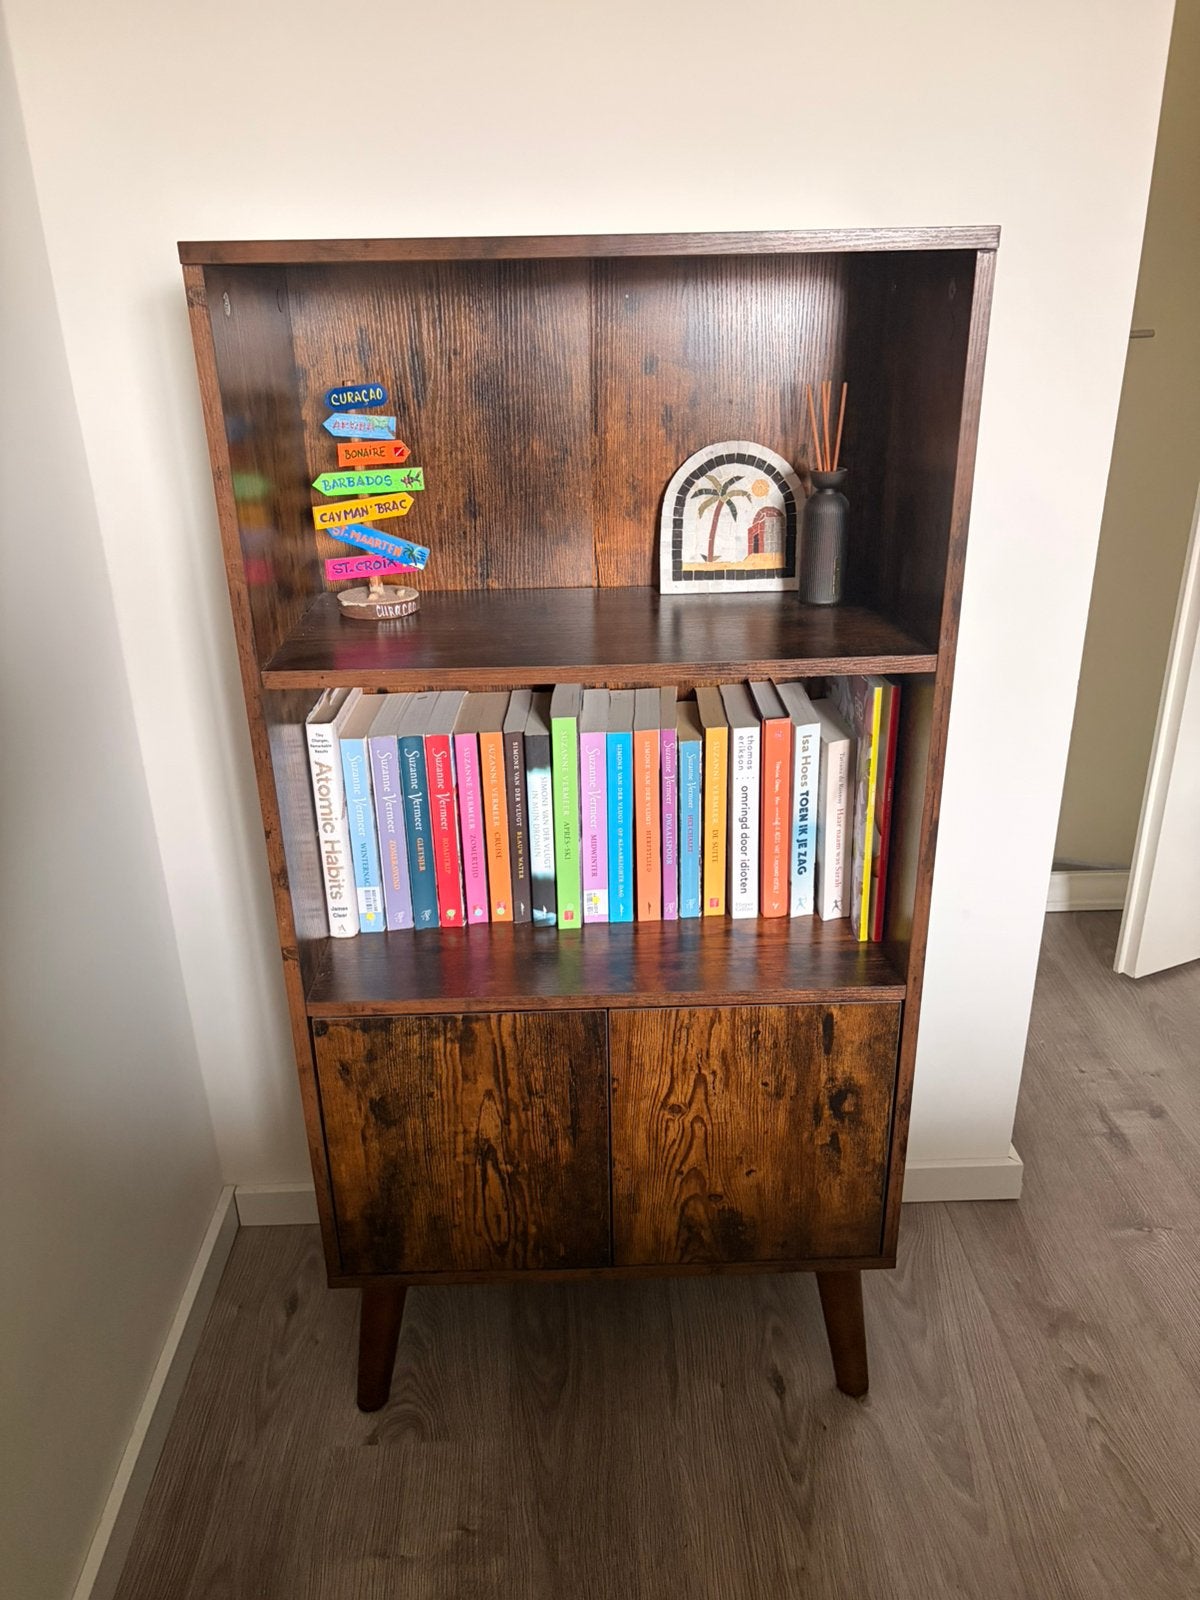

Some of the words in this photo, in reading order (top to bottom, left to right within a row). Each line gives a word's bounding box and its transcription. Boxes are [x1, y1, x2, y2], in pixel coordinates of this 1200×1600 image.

[331, 387, 383, 405] CURAÇAO
[321, 475, 393, 491] BARBADOS
[350, 530, 403, 557] MAARTEN
[560, 731, 569, 773] SUZANNE
[663, 741, 675, 773] Suzanne
[801, 734, 812, 752] Isa
[346, 752, 362, 795] Suzanne
[377, 750, 391, 793] Suzanne
[404, 748, 420, 790] Suzanne
[432, 747, 447, 789] Suzanne
[488, 744, 497, 785] SUZANNE
[585, 745, 600, 788] Suzanne
[686, 752, 697, 781] Suzanne
[800, 755, 812, 787] Hoes
[314, 760, 336, 834] Atomic
[463, 747, 473, 788] SUZANNE
[468, 790, 476, 830] VERMEER
[491, 787, 499, 827] VERMEER
[562, 776, 570, 816] VERMEER
[664, 775, 675, 805] Vermeer
[686, 782, 697, 809] Vermeer
[739, 785, 750, 830] omringd
[798, 790, 809, 822] TOEN
[352, 797, 367, 837] Vermeer
[382, 795, 397, 833] Vermeer
[408, 791, 423, 831] Vermeer
[436, 791, 451, 831] Vermeer
[588, 790, 601, 829] Vermeer
[836, 808, 845, 828] Haar
[740, 832, 750, 856] door
[797, 838, 809, 850] JE
[798, 824, 809, 836] IK
[835, 829, 843, 850] naam
[324, 839, 345, 901] Habits
[360, 842, 372, 887] WINTERNAC
[740, 858, 750, 894] idioten
[797, 851, 808, 875] ZAG
